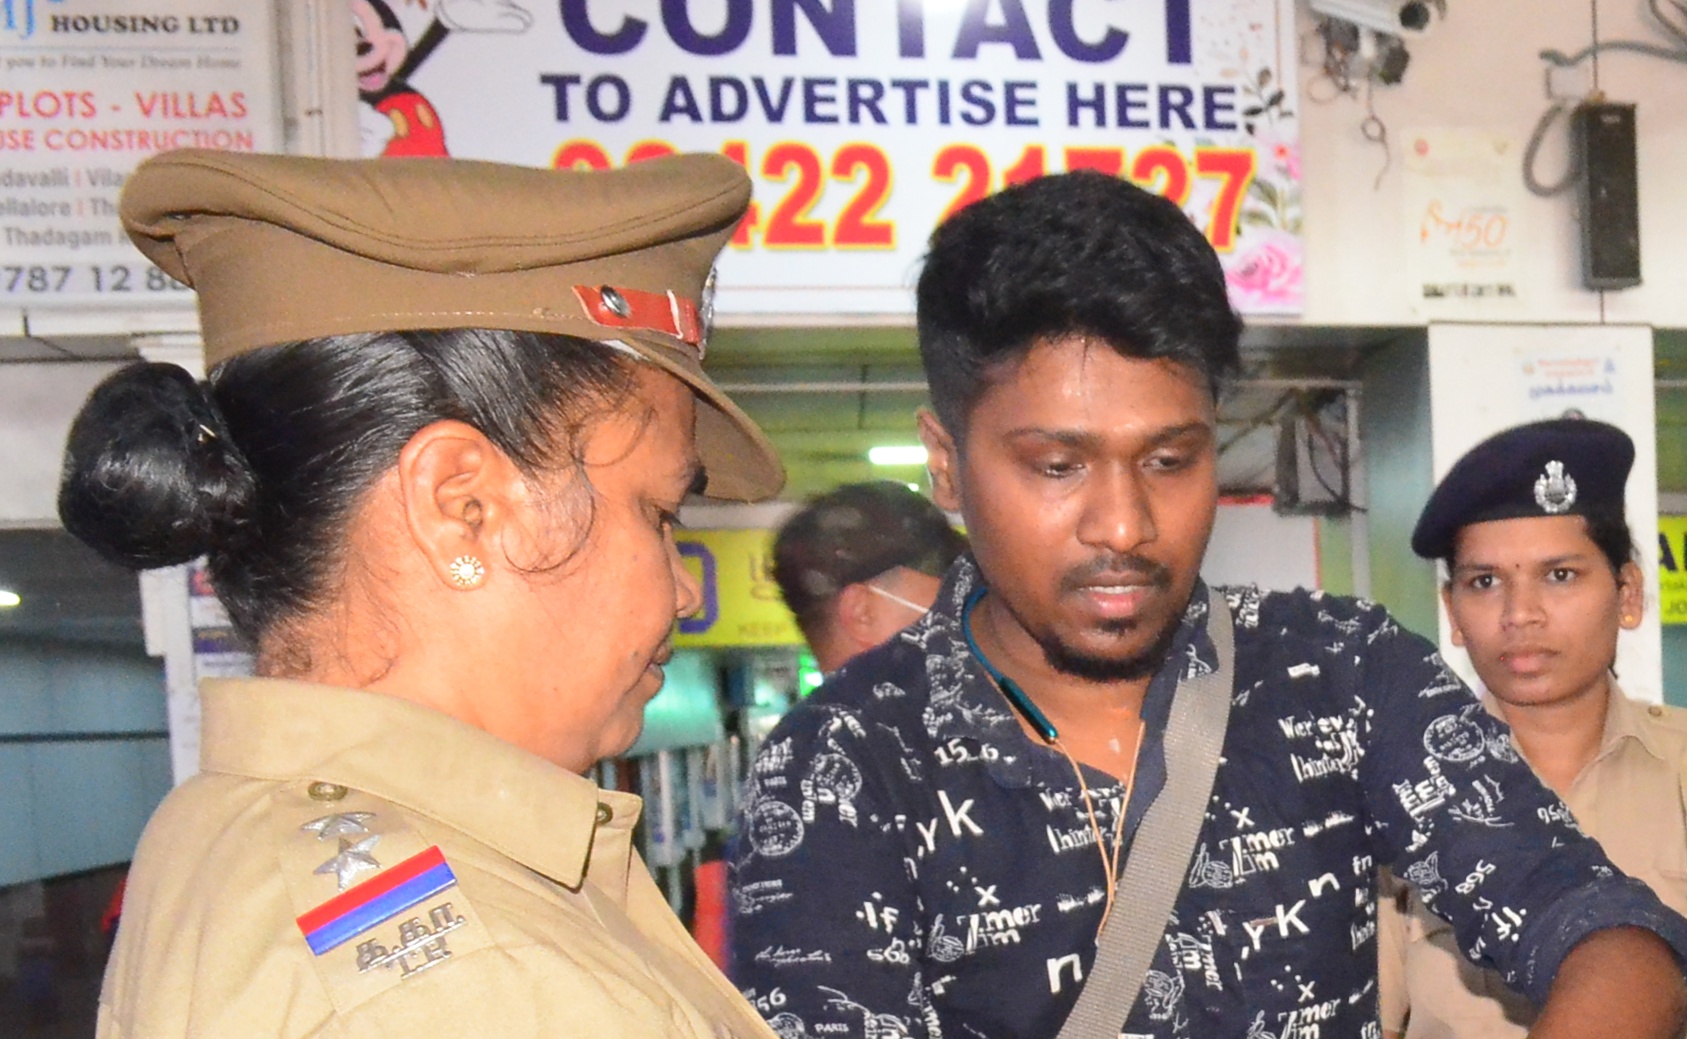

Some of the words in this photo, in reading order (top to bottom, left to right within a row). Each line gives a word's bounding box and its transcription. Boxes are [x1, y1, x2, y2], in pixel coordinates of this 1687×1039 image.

[51, 15, 179, 33] HOUSING
[188, 17, 240, 34] LTD
[558, 0, 1194, 65] CONTACT
[0, 90, 97, 119] PLOTS
[133, 90, 248, 119] VILLAS
[540, 73, 632, 123] TO
[658, 75, 1040, 127] ADVERTISE
[1067, 83, 1238, 130] HERE
[44, 128, 254, 151] CONSTRUCTION
[6, 266, 72, 292] 787
[92, 266, 132, 292] 12
[814, 1022, 850, 1034] PARIS
